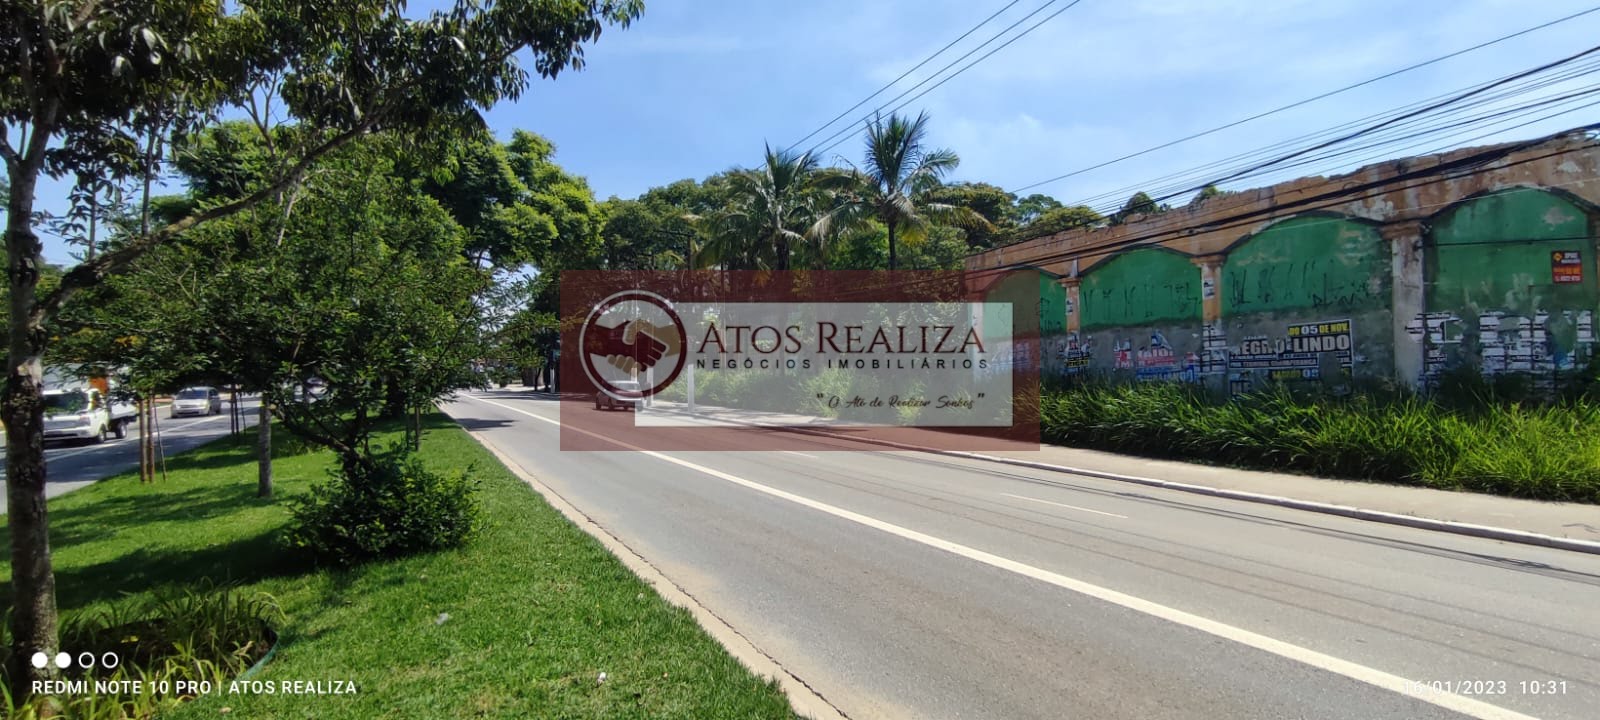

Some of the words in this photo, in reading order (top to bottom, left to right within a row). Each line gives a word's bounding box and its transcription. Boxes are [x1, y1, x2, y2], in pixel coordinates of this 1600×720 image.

[1301, 325, 1319, 335] 05
[1319, 324, 1330, 333] DE
[1293, 334, 1350, 353] LINDO
